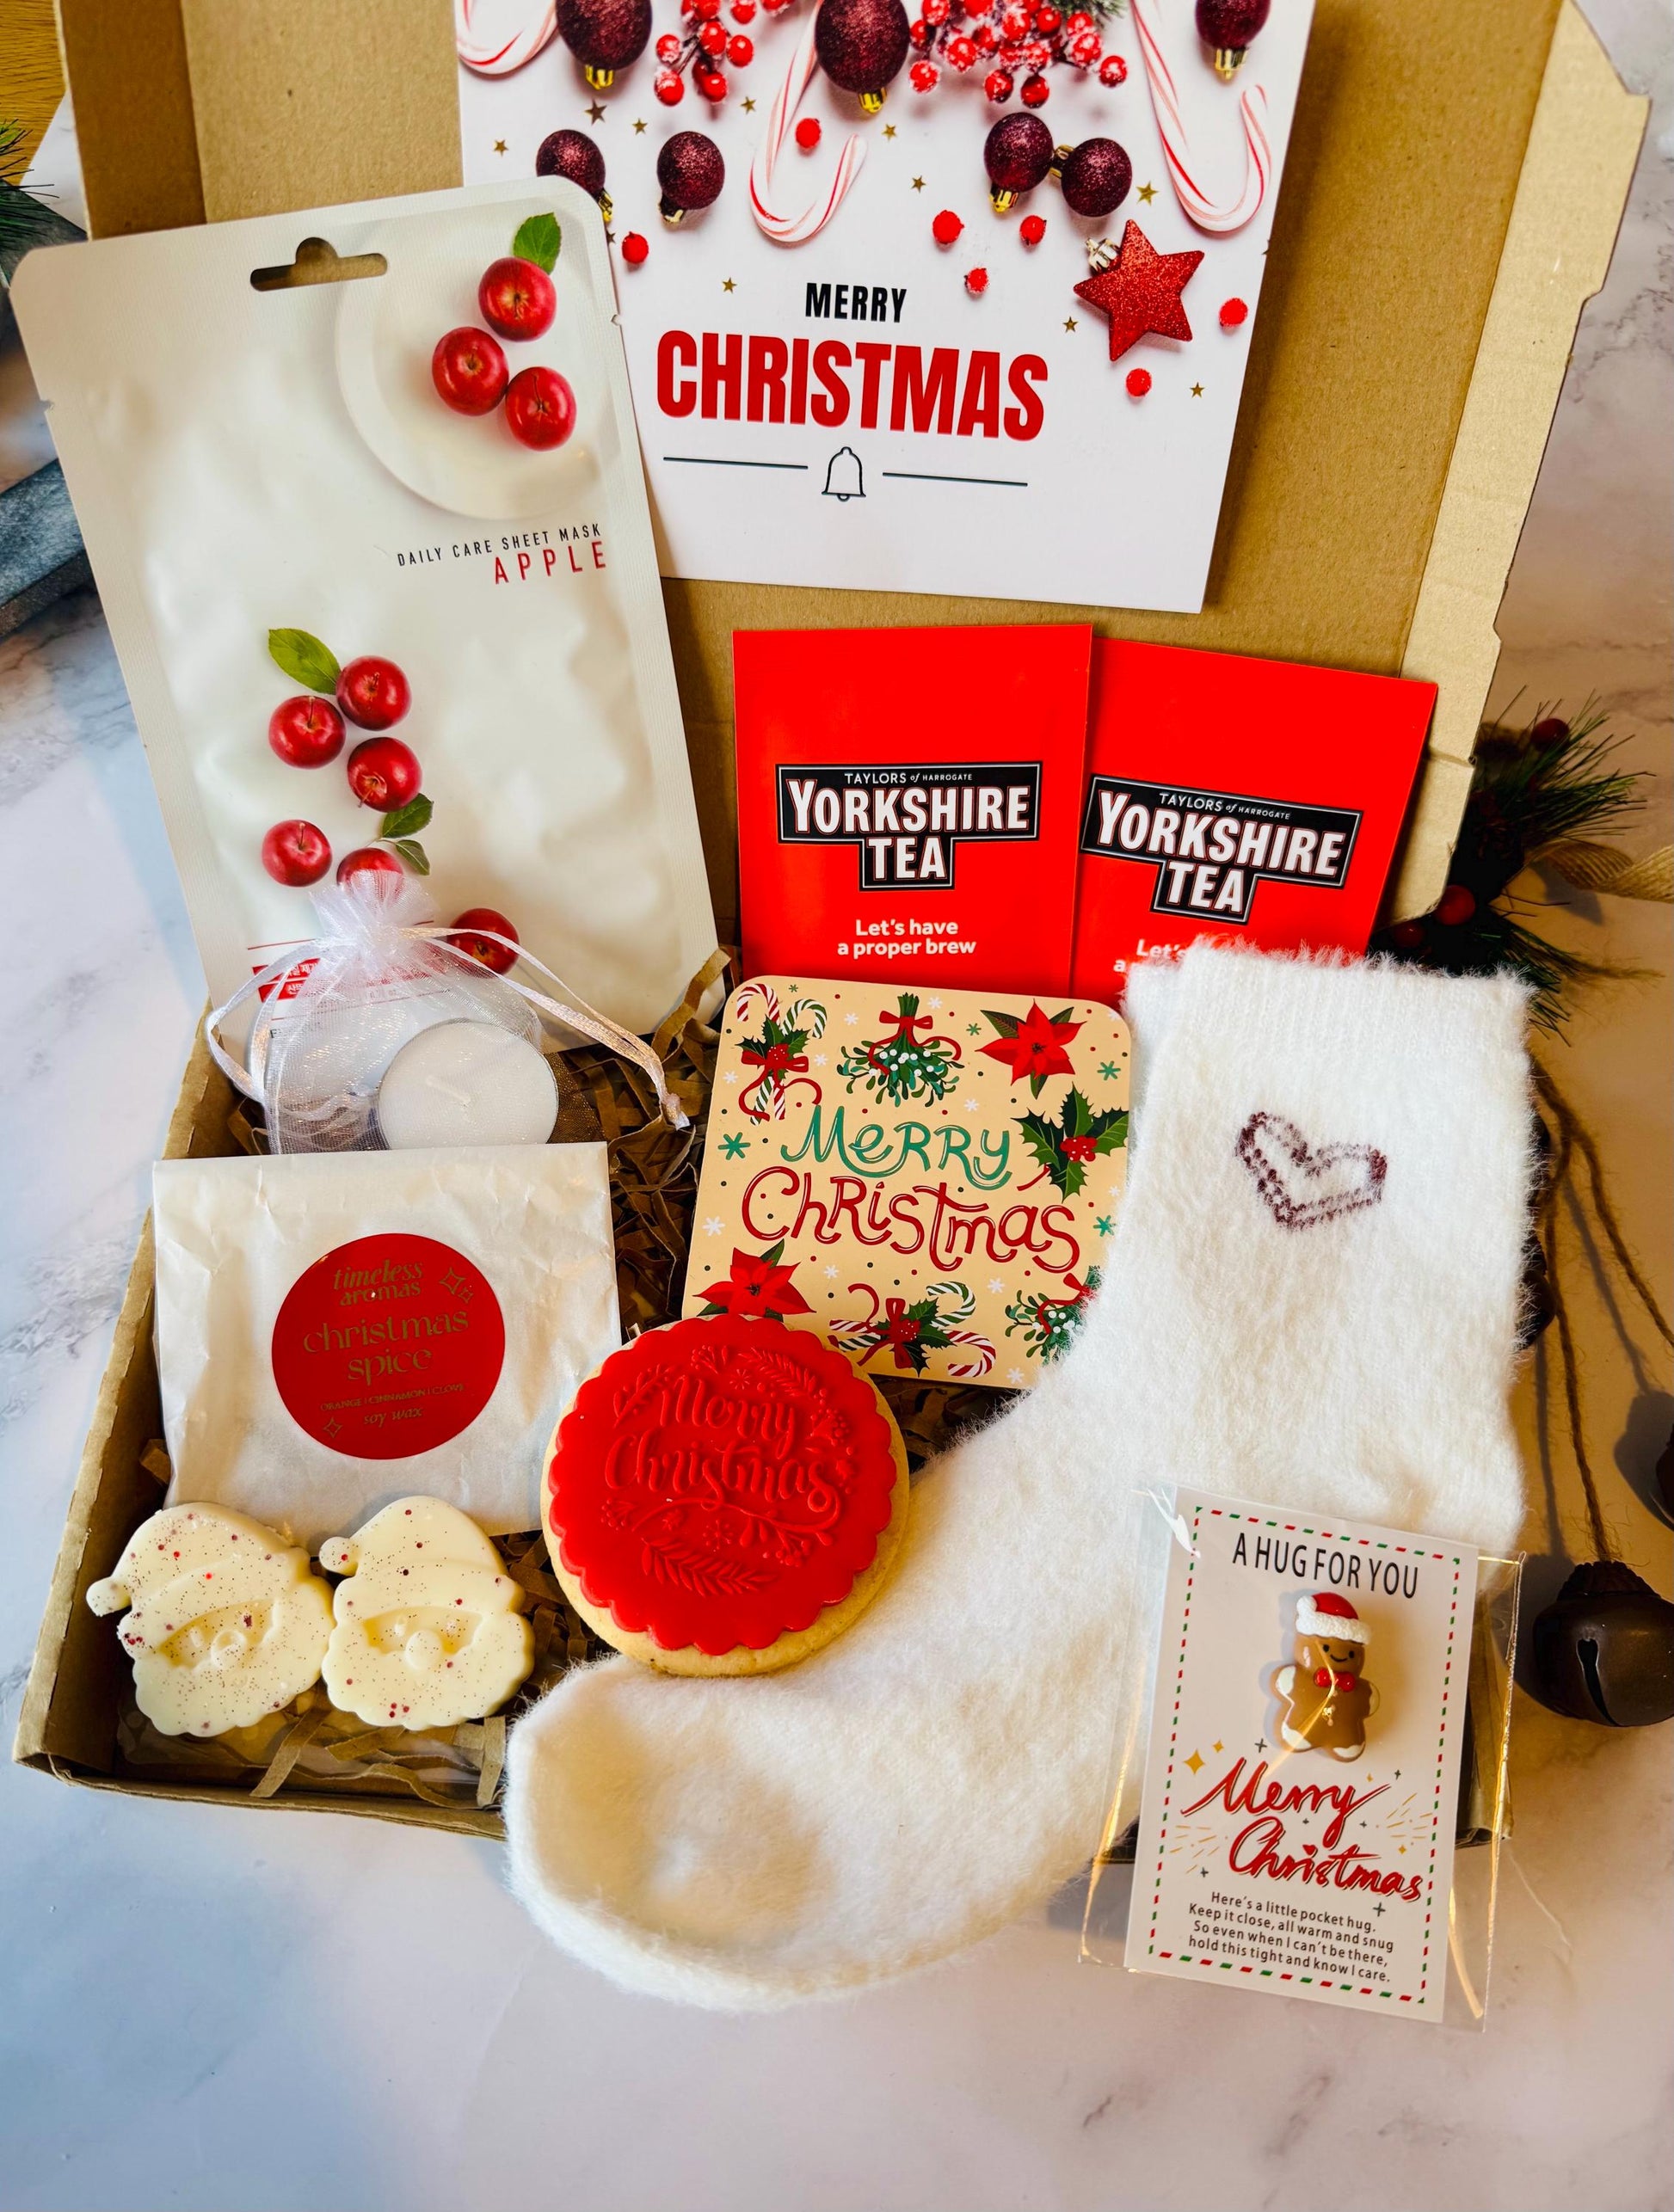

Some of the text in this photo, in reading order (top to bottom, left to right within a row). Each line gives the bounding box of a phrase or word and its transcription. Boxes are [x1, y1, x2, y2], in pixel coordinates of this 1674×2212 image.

[804, 282, 907, 323] MERRY
[657, 329, 1048, 441] CHRISTMAS
[397, 523, 601, 567] DAILY CARE SHEET MASK
[495, 540, 606, 585] APPLE
[844, 772, 973, 784] TAYLORS of HARROGATE
[786, 778, 1031, 834] YORKSHIRE
[1159, 793, 1291, 820] TAYLORS of HARROGATE
[1097, 790, 1346, 878] YORKSHIRE
[866, 835, 948, 881] TEA
[1166, 860, 1245, 915] TEA
[837, 938, 976, 959] a proper brew
[855, 919, 958, 936] Let's have
[1113, 959, 1126, 973] a
[333, 1259, 423, 1290] timeless
[339, 1281, 422, 1306] aromas
[303, 1310, 470, 1353] christmas
[348, 1349, 433, 1386] spice
[320, 1398, 362, 1411] ORANGE
[367, 1389, 426, 1404] CINNAMON
[363, 1407, 424, 1429] soy wax
[657, 1374, 797, 1459] Merry
[605, 1429, 841, 1512] Christmas
[1233, 1532, 1419, 1599] A HUG FOR YOU
[1179, 1756, 1392, 1850] Merry
[1228, 1816, 1425, 1902] Christmas
[1189, 1902, 1394, 1953] Keep it close, all warm and snug
[1211, 1891, 1376, 1934] Here's a little pocket hug.
[1188, 1935, 1391, 1983] hold this tight and know I care.
[1193, 1920, 1388, 1967] So even when I can't be there,
